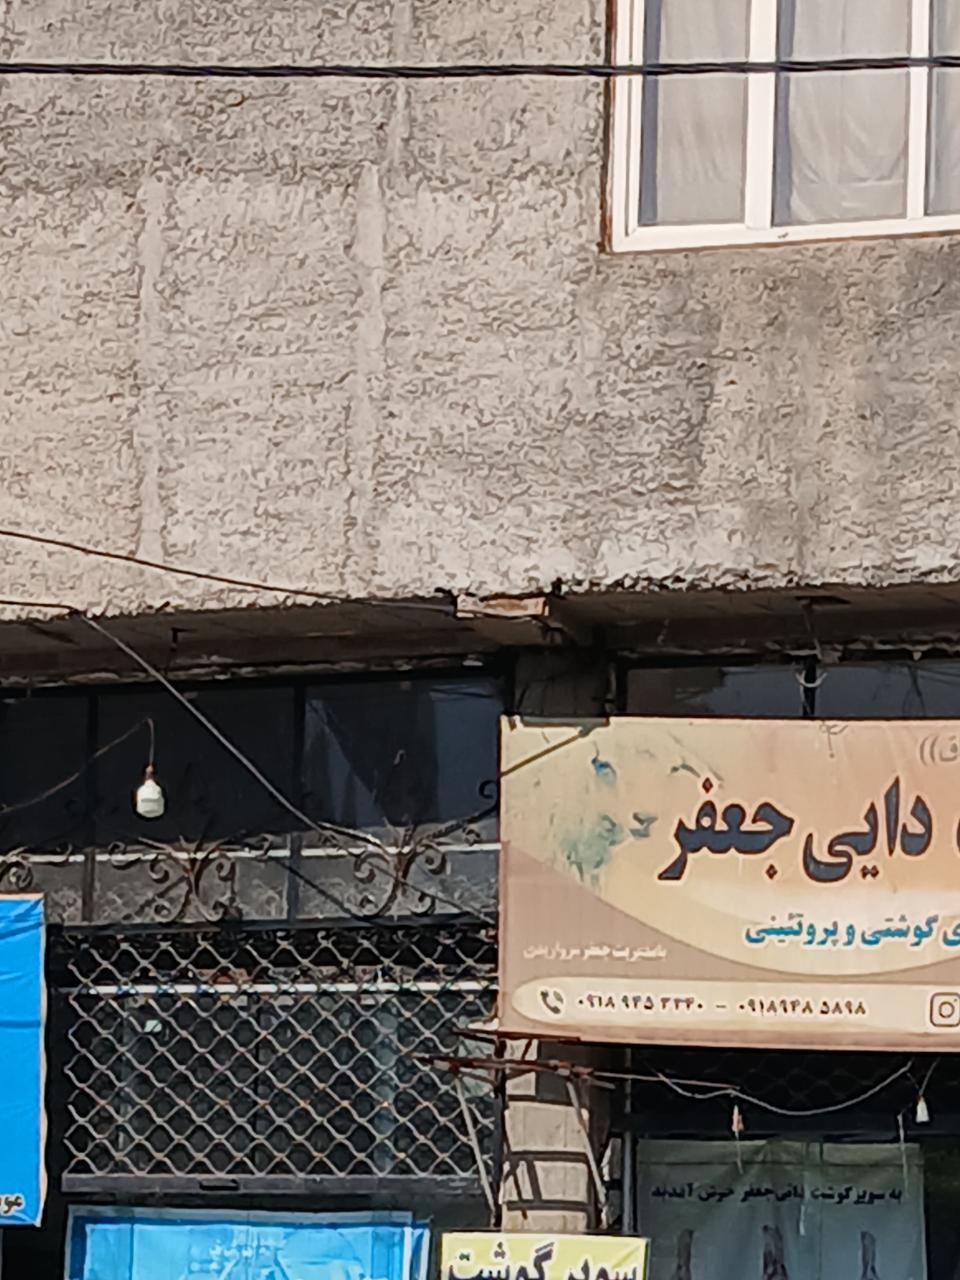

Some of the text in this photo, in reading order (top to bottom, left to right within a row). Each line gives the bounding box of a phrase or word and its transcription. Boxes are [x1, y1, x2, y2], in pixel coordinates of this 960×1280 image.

[657, 777, 795, 881] جعفر
[802, 776, 933, 883] دایی
[861, 913, 940, 947] گوشتی
